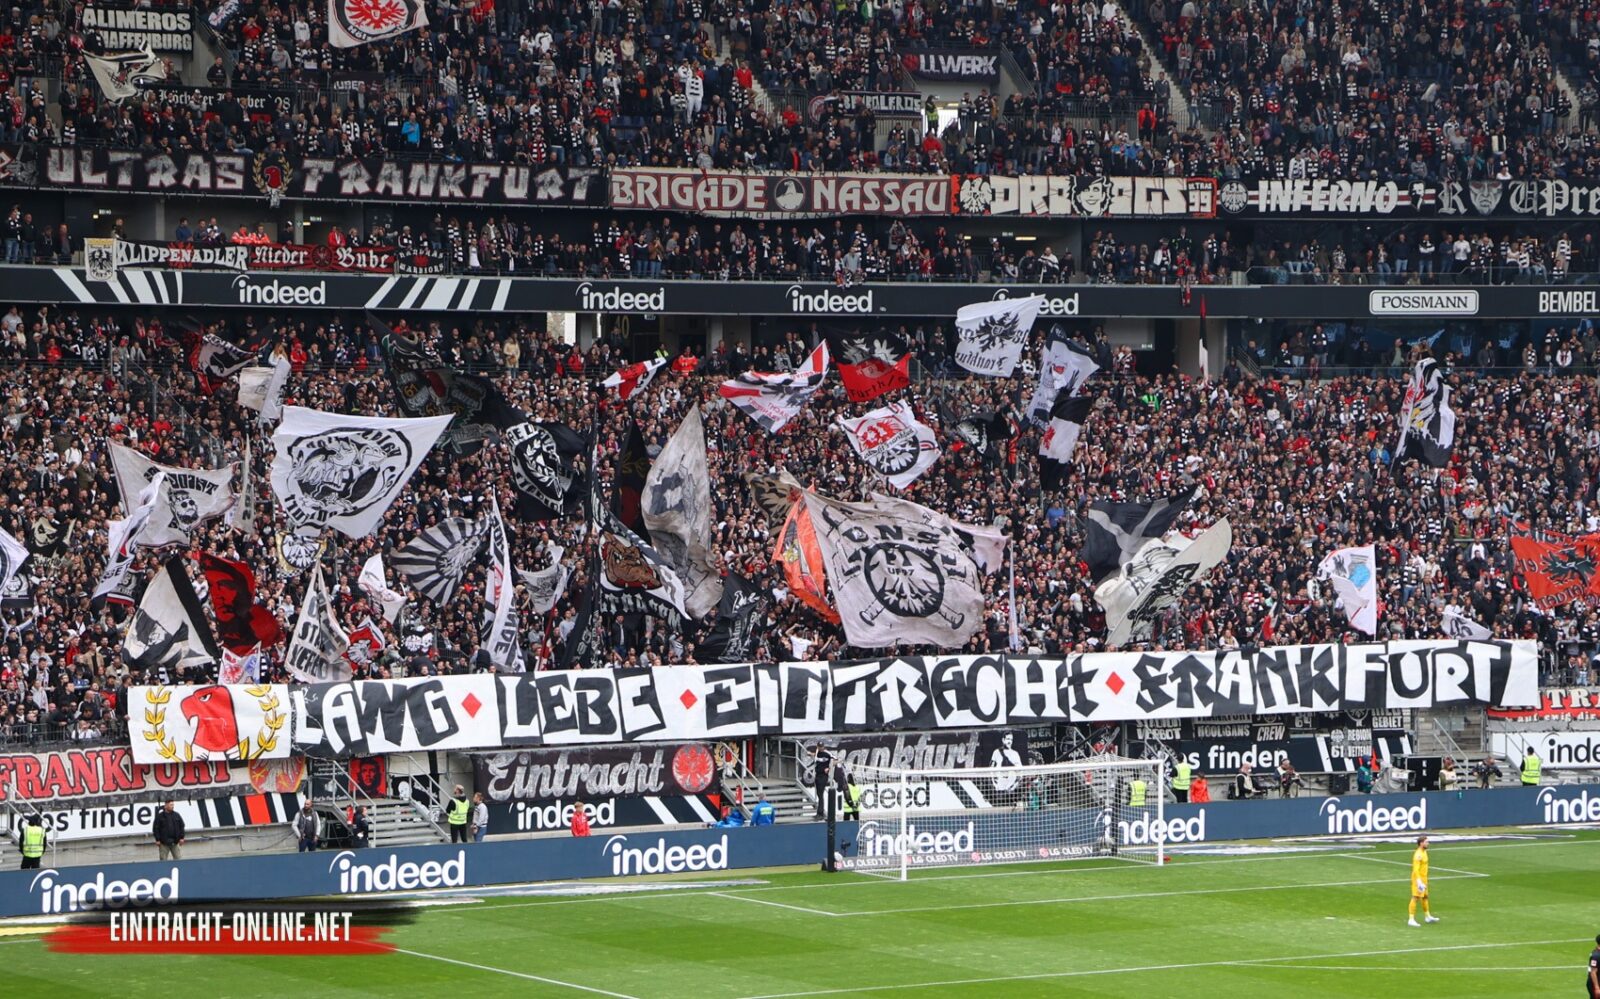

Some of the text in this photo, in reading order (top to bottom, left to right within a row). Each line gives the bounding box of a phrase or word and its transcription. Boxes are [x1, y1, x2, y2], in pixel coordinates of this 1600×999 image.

[82, 8, 191, 31] ALIMEROS
[46, 148, 600, 200] ULTRAS FRANKFURT
[612, 173, 948, 214] BRIGADE NASSAU
[1188, 190, 1213, 212] 99
[1258, 179, 1399, 214] INFERNO
[116, 240, 249, 271] KLIPPENADLER
[336, 246, 390, 269] Bube
[238, 278, 326, 305] indeed
[581, 286, 665, 311] indeed
[792, 288, 873, 313] indeed
[1380, 295, 1468, 310] POSSMANN
[1538, 291, 1600, 313] BEMBEL
[295, 640, 1501, 755] LANG LEBE EINTRACHT FRANKFURT
[1257, 726, 1285, 741] CREW
[1208, 745, 1288, 769] finden
[487, 747, 664, 800] Eintracht
[517, 799, 615, 830] indeed
[1101, 808, 1205, 844] indeed
[1327, 797, 1427, 834] indeed
[865, 821, 974, 857] indeed
[612, 834, 728, 876] indeed
[842, 860, 854, 868] LG
[857, 859, 877, 867] OLED
[912, 856, 924, 864] LG
[980, 852, 992, 860] LG
[339, 850, 466, 893] indeed
[40, 867, 179, 913] indeed
